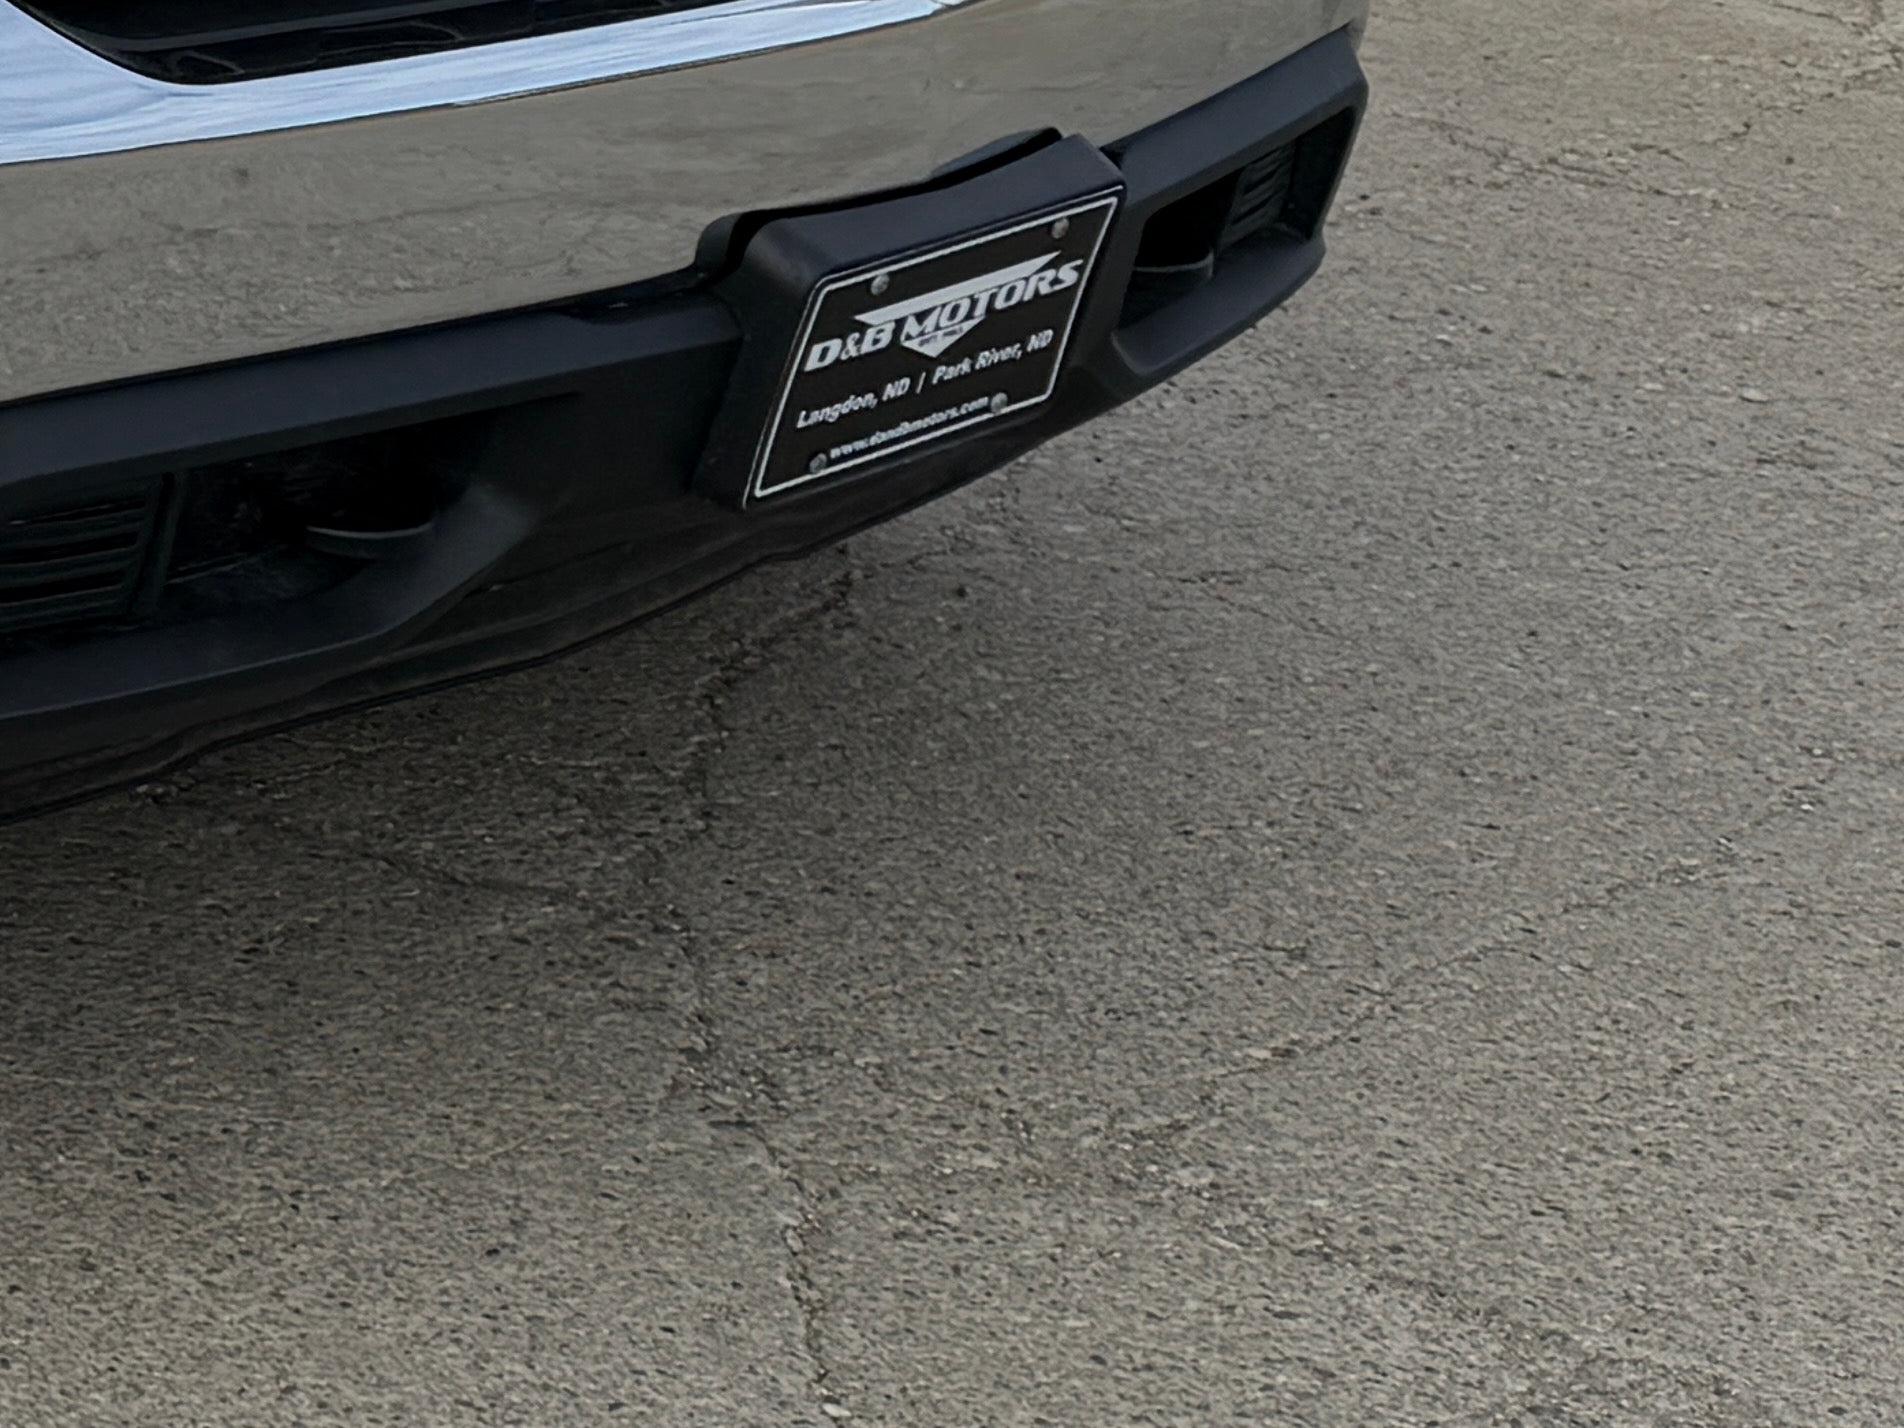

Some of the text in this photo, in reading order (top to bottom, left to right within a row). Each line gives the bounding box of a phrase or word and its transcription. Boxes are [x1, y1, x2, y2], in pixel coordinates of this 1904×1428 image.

[804, 259, 1084, 372] D&B MOTORS
[796, 392, 878, 429] Langdon,
[882, 377, 912, 401] ND
[932, 357, 972, 384] Park
[975, 343, 1022, 370] River,
[1026, 329, 1053, 352] ND
